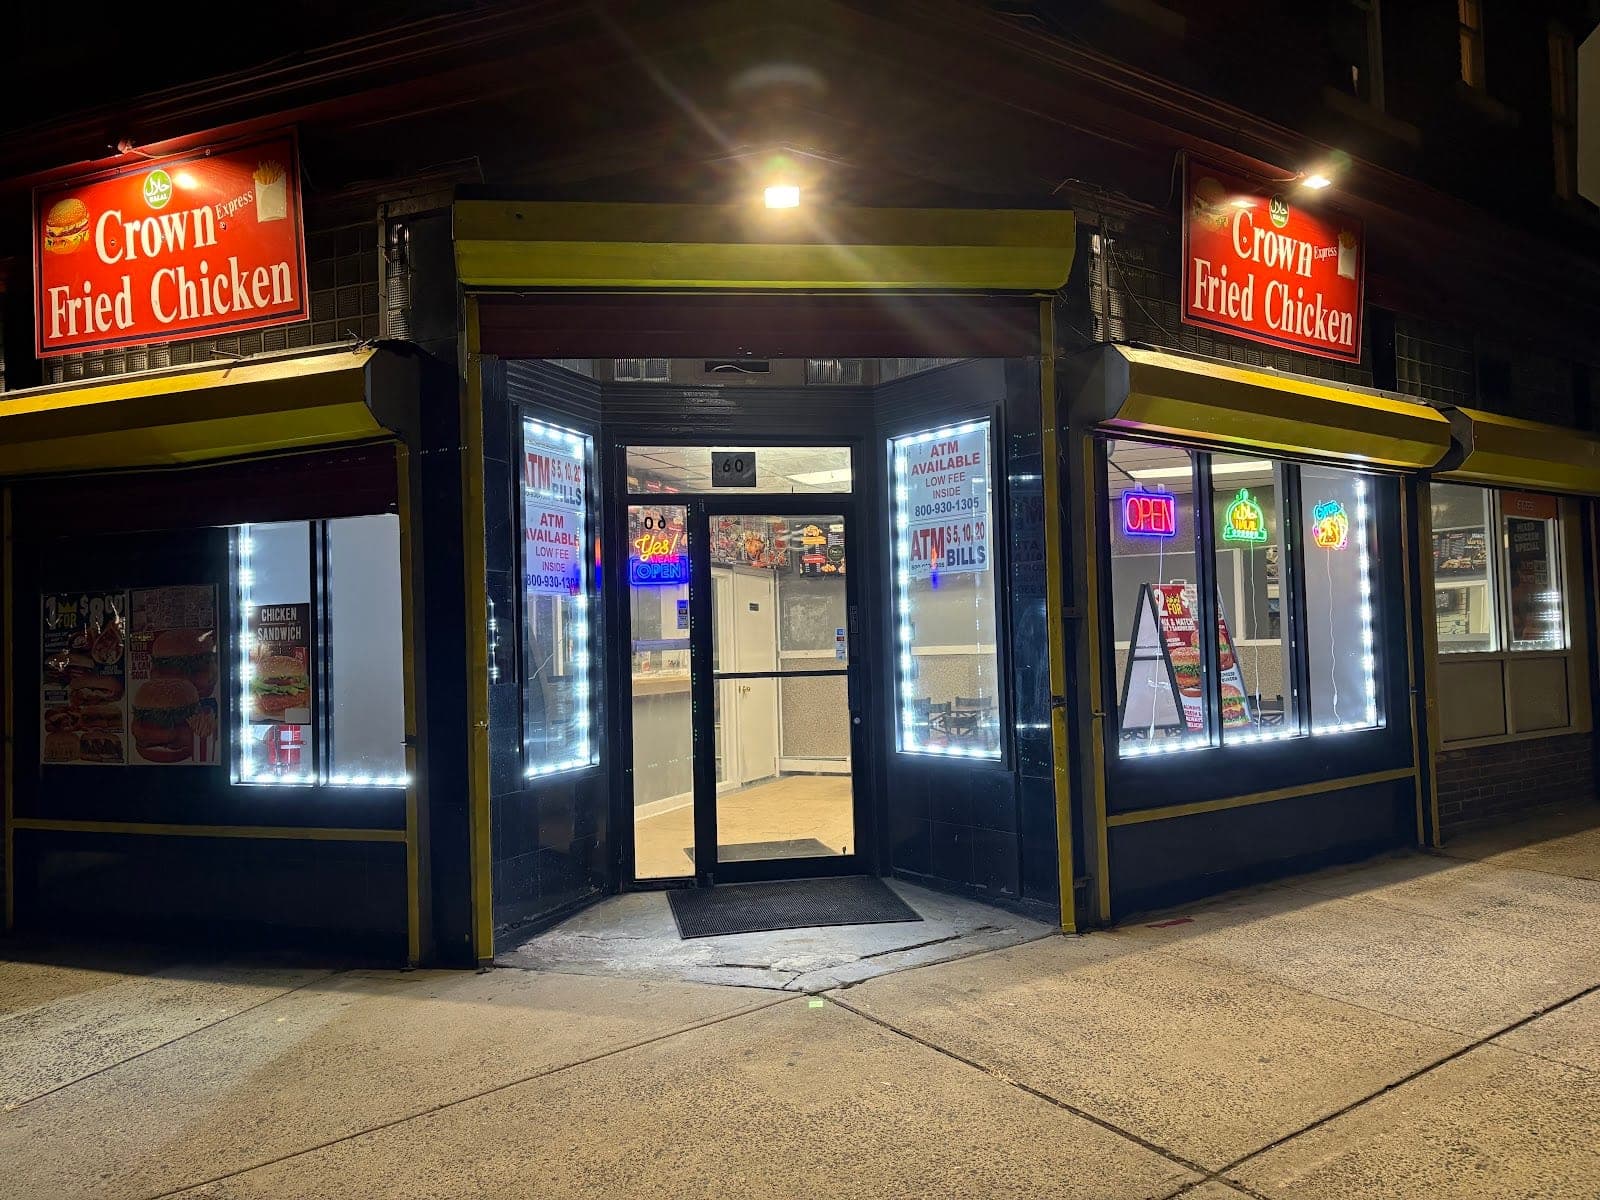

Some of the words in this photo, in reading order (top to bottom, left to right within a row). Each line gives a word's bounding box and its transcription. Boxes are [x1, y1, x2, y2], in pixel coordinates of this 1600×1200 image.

[215, 189, 253, 220] Express
[95, 204, 217, 264] Crown
[1232, 209, 1313, 278] Crown
[1314, 246, 1338, 260] Express
[48, 275, 135, 339] Fried
[151, 256, 294, 323] Chicken
[1192, 258, 1255, 322] Fried
[1265, 280, 1353, 346] Chicken
[931, 440, 959, 458] ATM
[722, 459, 744, 473] 60
[911, 452, 981, 477] AVAILABLE
[925, 474, 946, 488] LOW
[948, 472, 966, 484] FEE
[552, 483, 582, 506] BILLS
[933, 486, 961, 499] INSIDE
[915, 497, 979, 517] 800-930-1305
[1126, 497, 1174, 531] OPEN
[540, 512, 564, 529] ATM
[975, 521, 985, 541] 20
[536, 545, 553, 558] LOW
[555, 548, 569, 559] FEE
[635, 533, 679, 562] Yes!
[911, 526, 945, 562] ATM
[946, 545, 986, 567] BILLS
[542, 560, 566, 572] INSIDE
[637, 563, 682, 579] OPEN
[527, 573, 578, 589] 800-930-130
[261, 607, 297, 622] CHICKEN
[1168, 603, 1183, 615] FOR
[257, 626, 302, 642] SANDWICH
